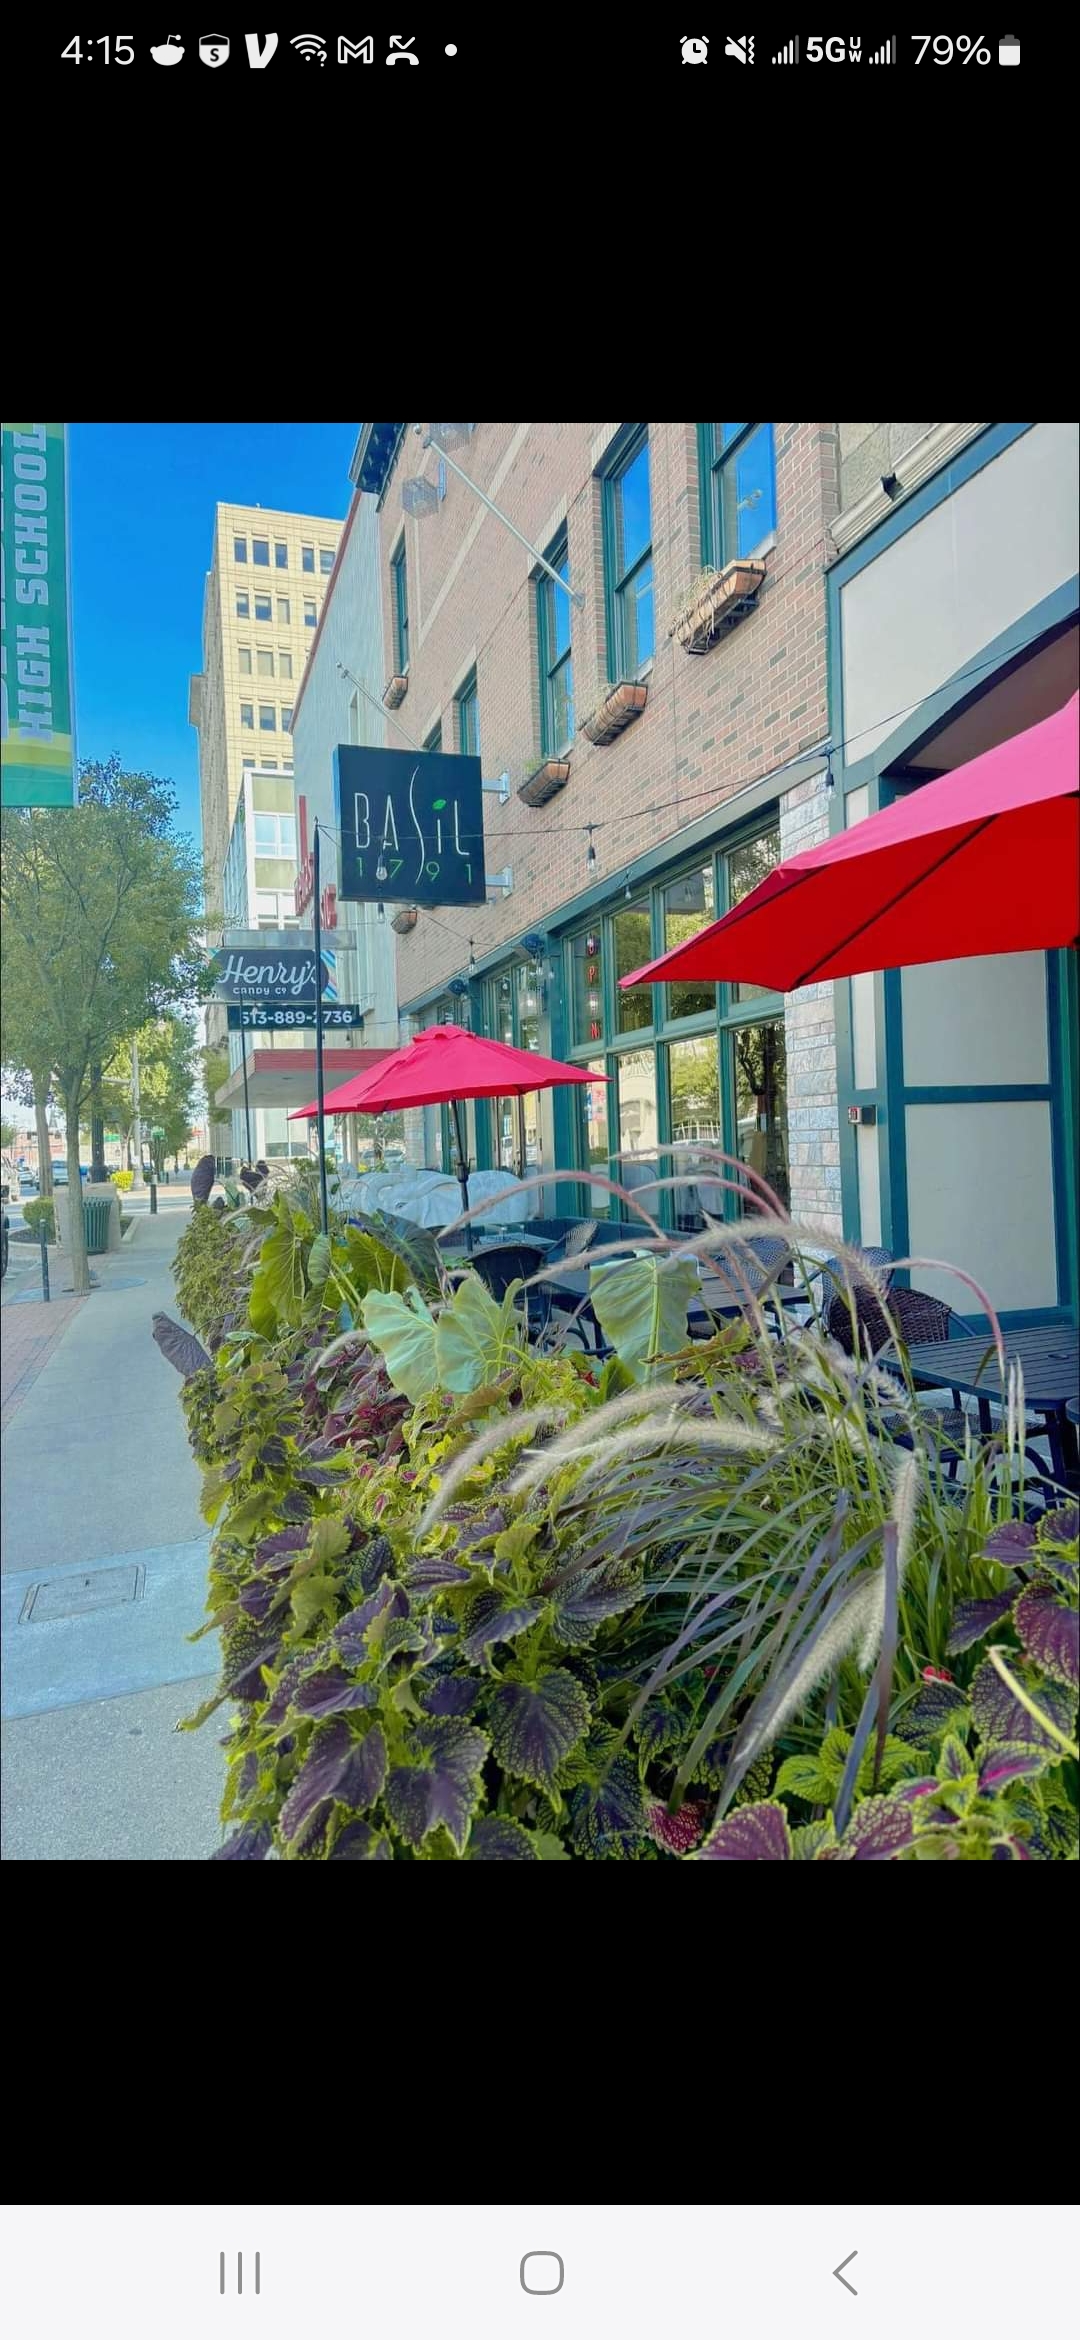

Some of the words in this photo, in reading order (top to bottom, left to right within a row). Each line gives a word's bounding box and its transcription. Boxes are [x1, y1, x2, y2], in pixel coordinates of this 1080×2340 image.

[13, 424, 49, 606] SCHOOL
[16, 624, 53, 740] HIGH
[356, 857, 473, 886] 1791
[233, 987, 269, 995] CANDY
